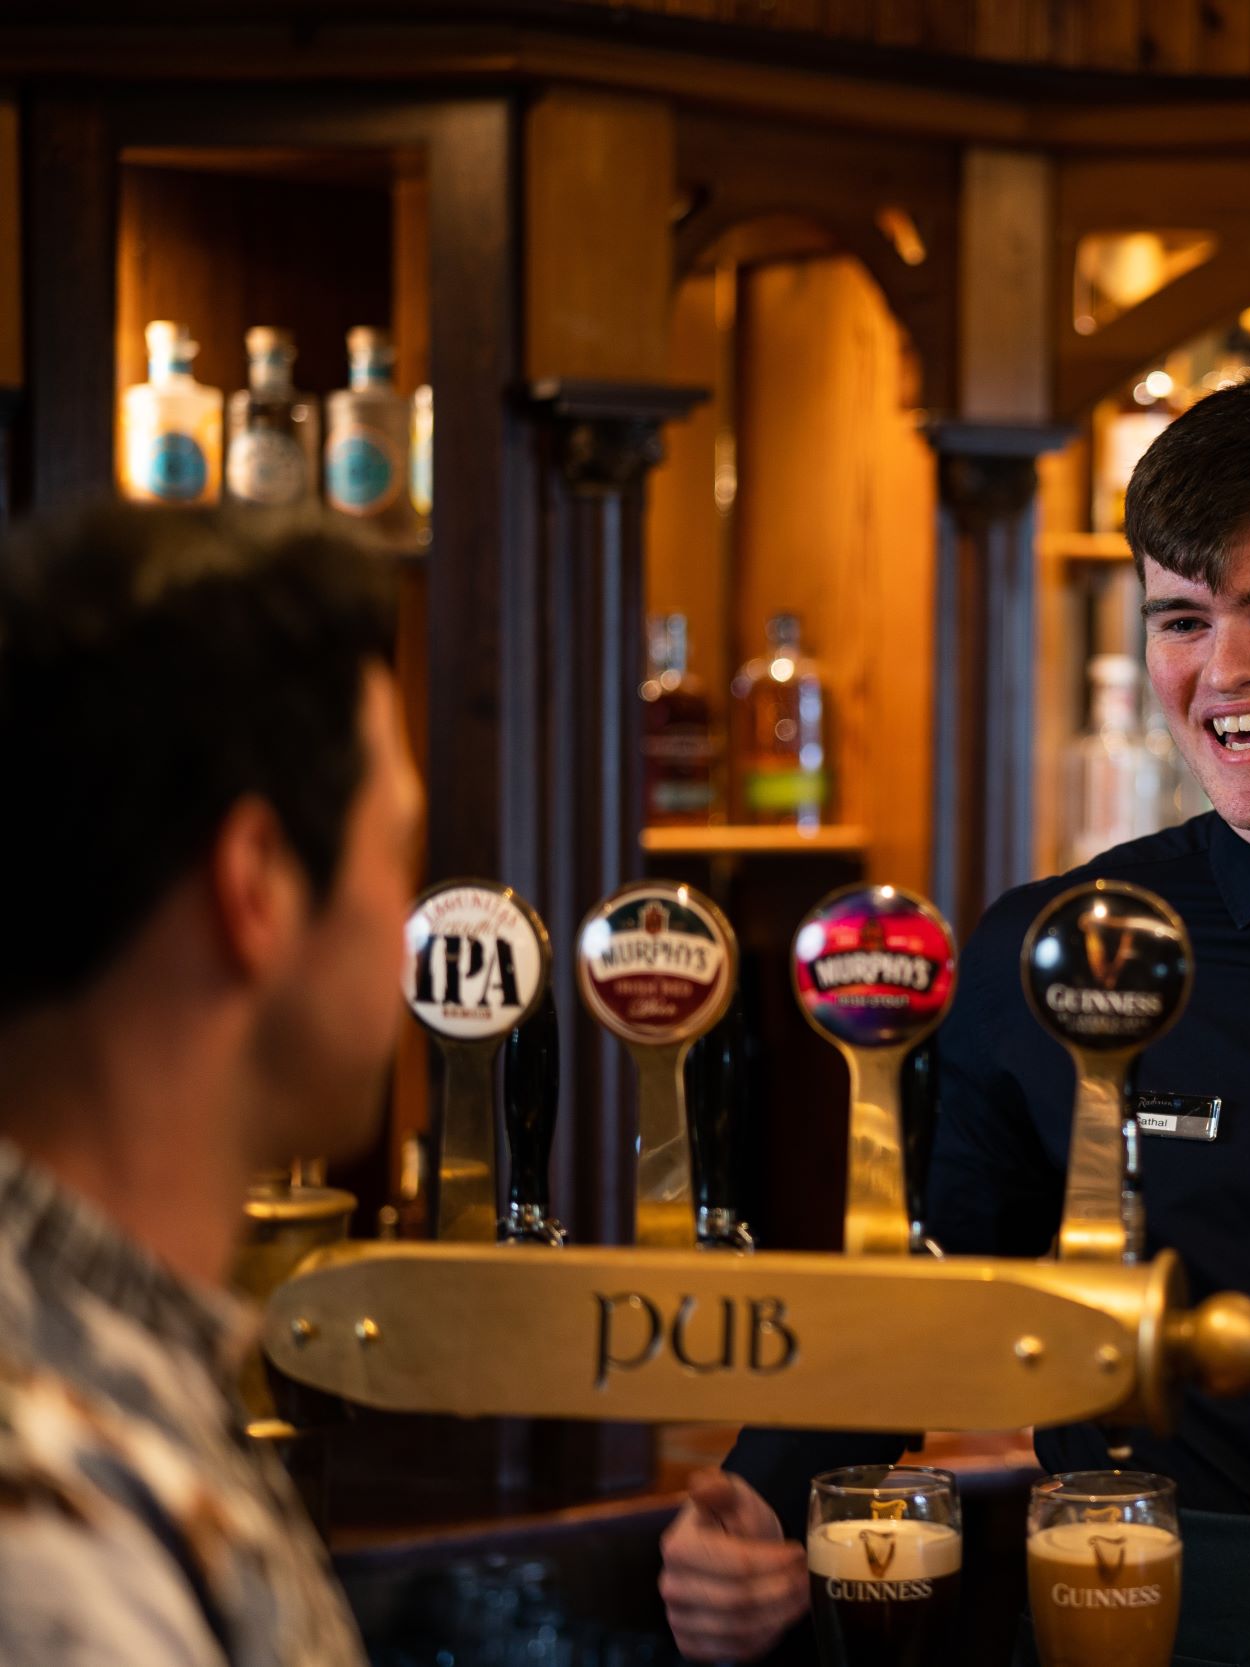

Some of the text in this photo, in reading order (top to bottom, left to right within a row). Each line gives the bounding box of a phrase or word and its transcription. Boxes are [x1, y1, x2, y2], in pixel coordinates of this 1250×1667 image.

[413, 933, 521, 1007] IPA
[1046, 983, 1164, 1017] GUINNESS
[593, 1293, 799, 1391] PUB
[826, 1576, 933, 1602] GUINNESS
[1051, 1582, 1160, 1608] GUINNESS
